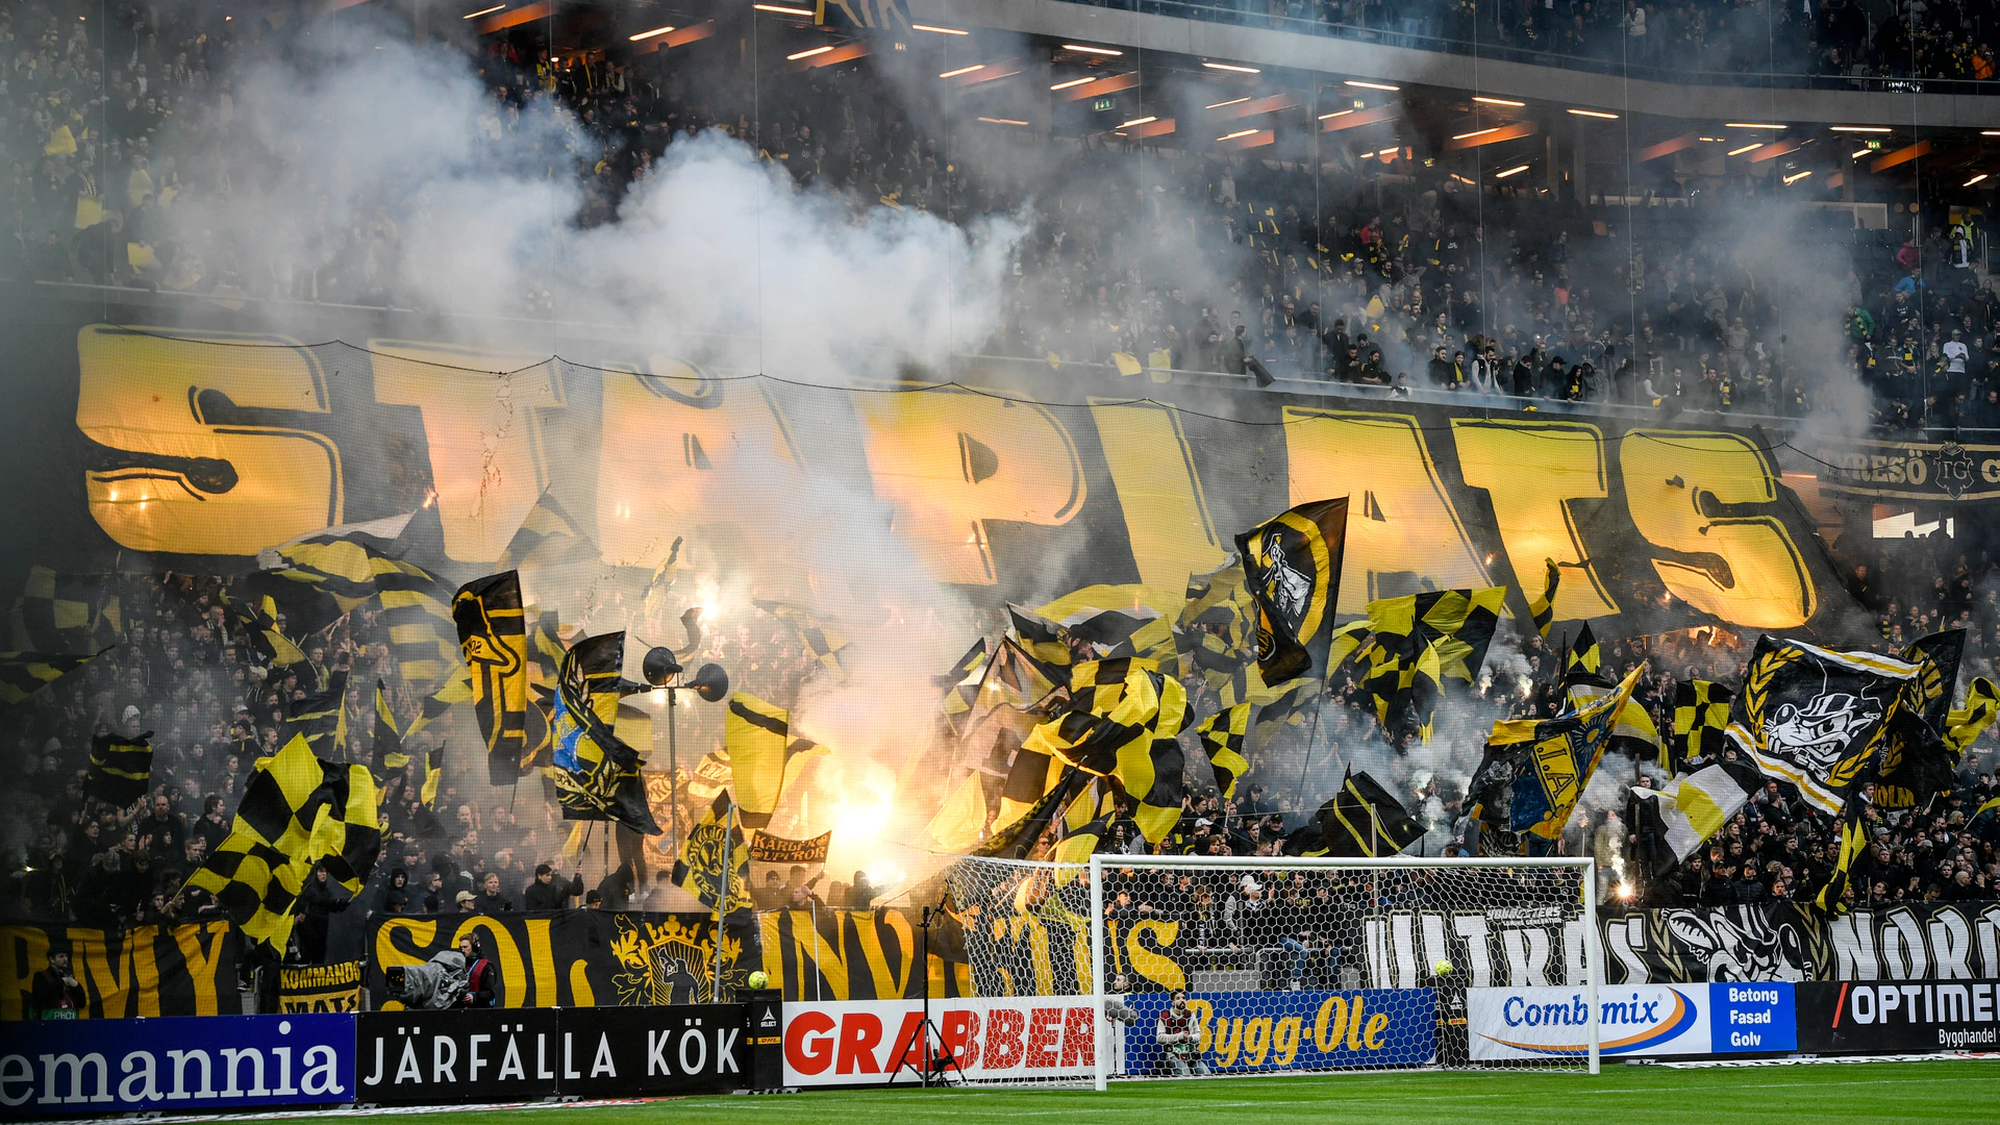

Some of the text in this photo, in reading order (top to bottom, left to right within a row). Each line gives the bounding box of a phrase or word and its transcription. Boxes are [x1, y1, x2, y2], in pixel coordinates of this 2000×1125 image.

[76, 322, 1816, 628] STÅPLATS
[1817, 449, 1928, 485] TYRESÖ
[1364, 911, 1653, 987] ULTRAS
[280, 960, 361, 990] KOMMANDO
[1503, 995, 1660, 1028] Combmix
[1728, 987, 1778, 1005] Betong
[1851, 983, 2000, 1025] OPTIME
[1730, 1010, 1771, 1025] Fasad
[364, 1018, 740, 1086] JÄRFÄLLA KÖK
[1731, 1031, 1761, 1047] Golv
[1938, 1028, 1997, 1047] Bygghandel
[0, 1021, 345, 1107] emannia
